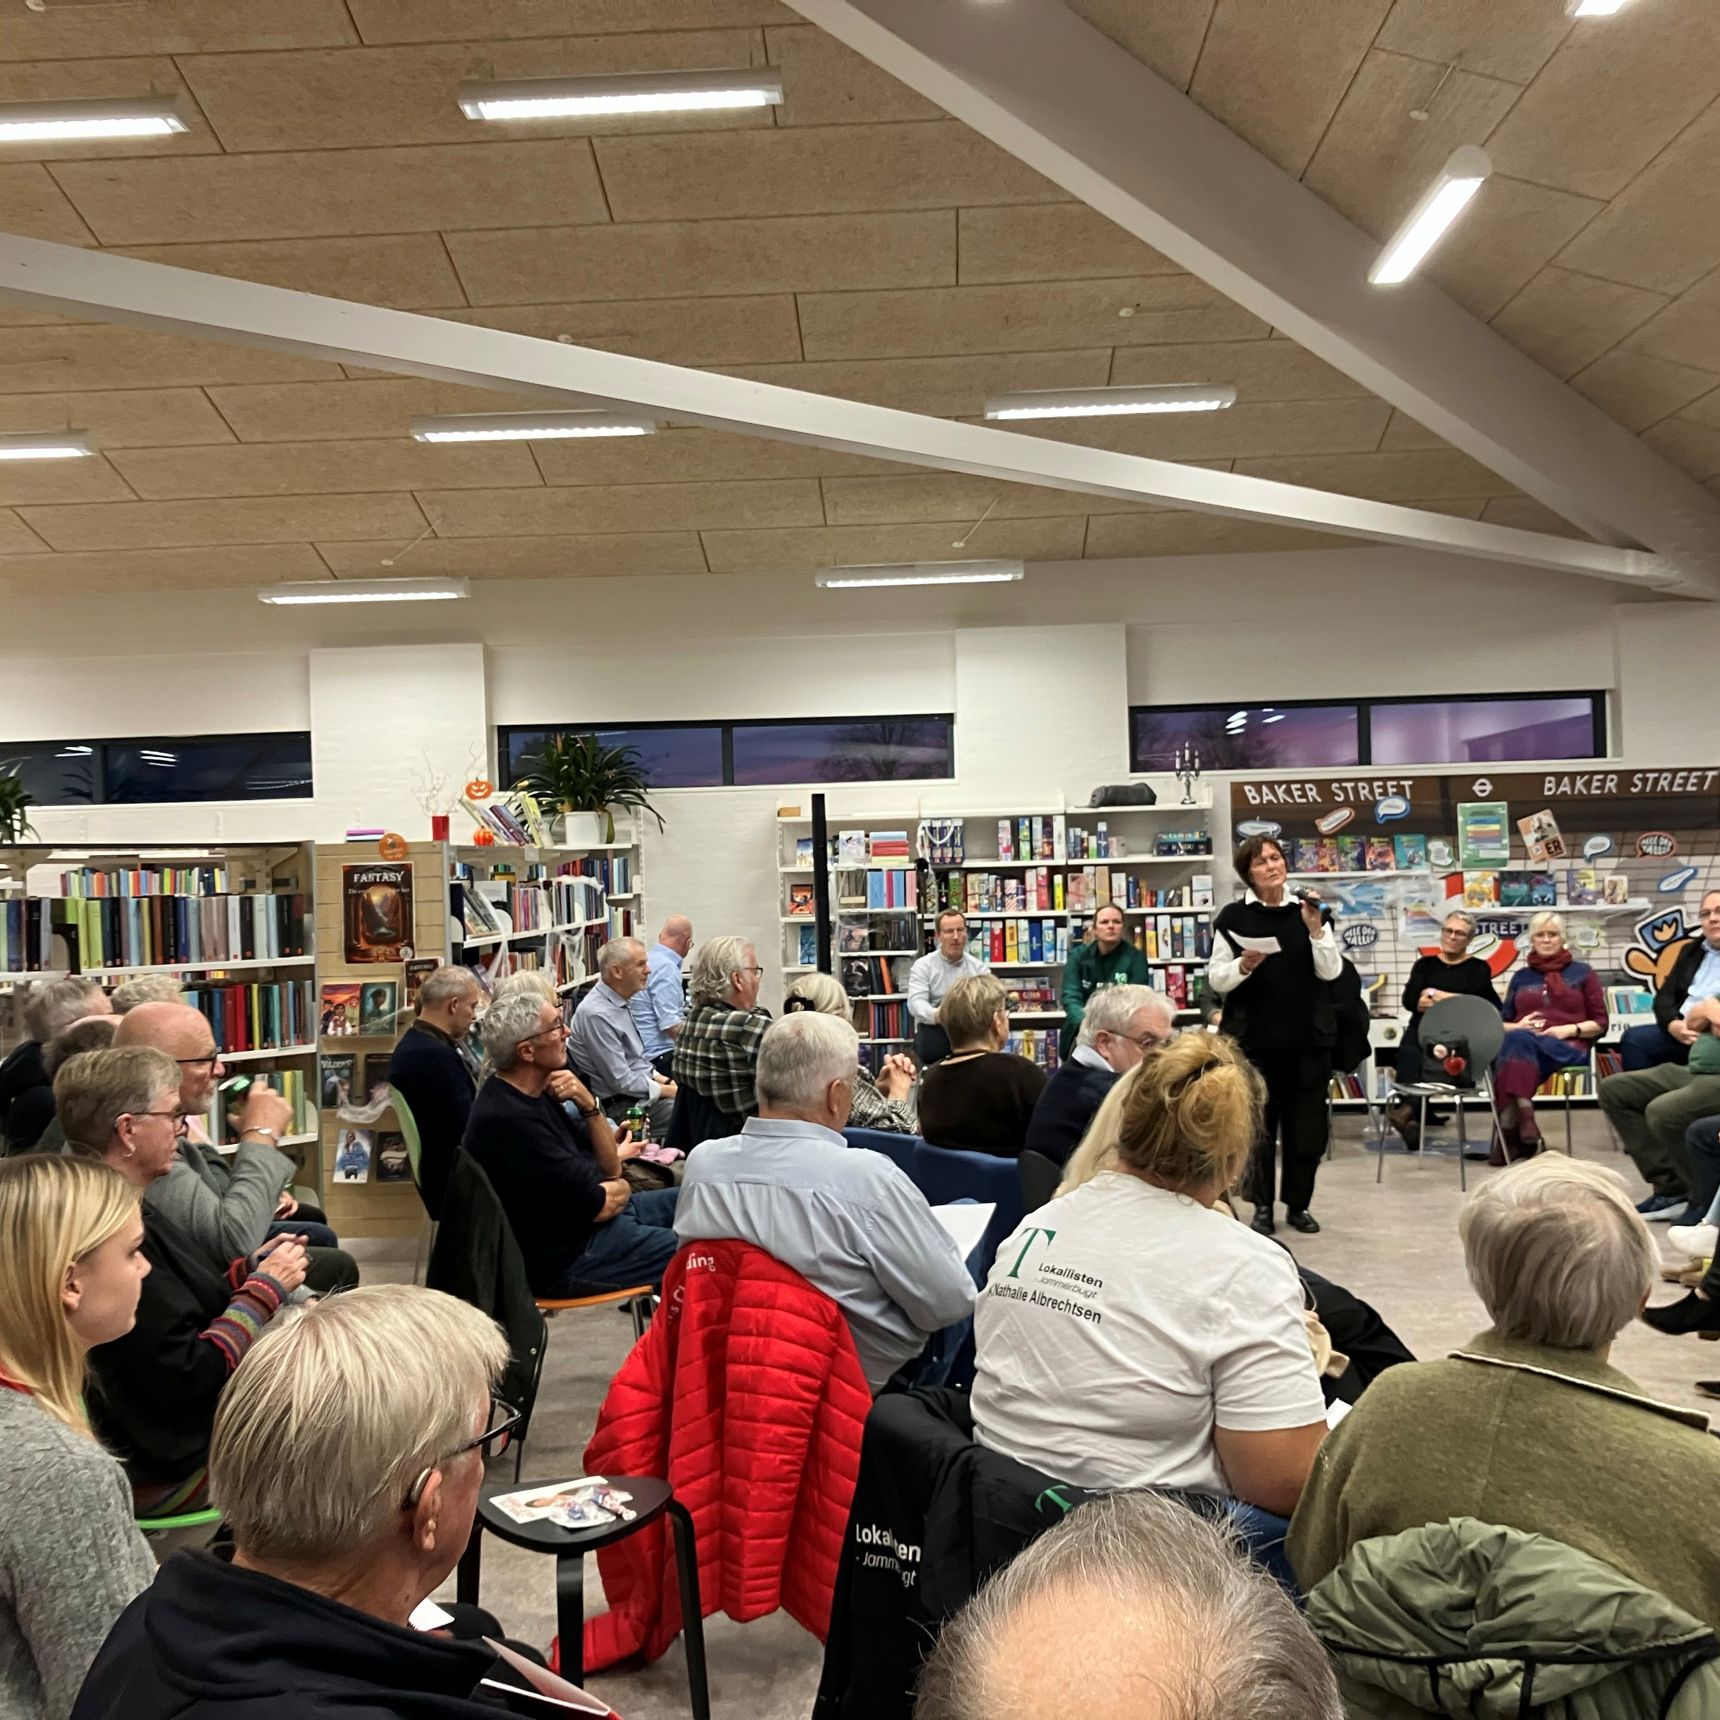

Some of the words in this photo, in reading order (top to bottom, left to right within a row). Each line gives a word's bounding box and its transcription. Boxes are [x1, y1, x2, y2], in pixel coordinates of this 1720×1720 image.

[1243, 783, 1322, 805] BAKER
[1331, 780, 1413, 803] STREET
[1543, 774, 1618, 796] BAKER
[1630, 770, 1720, 793] STREET
[353, 870, 405, 883] FANTASY
[1007, 1227, 1057, 1279] T
[1038, 1262, 1103, 1288] Lokallisten
[995, 1282, 1028, 1301] Nathalie
[1028, 1289, 1102, 1324] Albrechtsen
